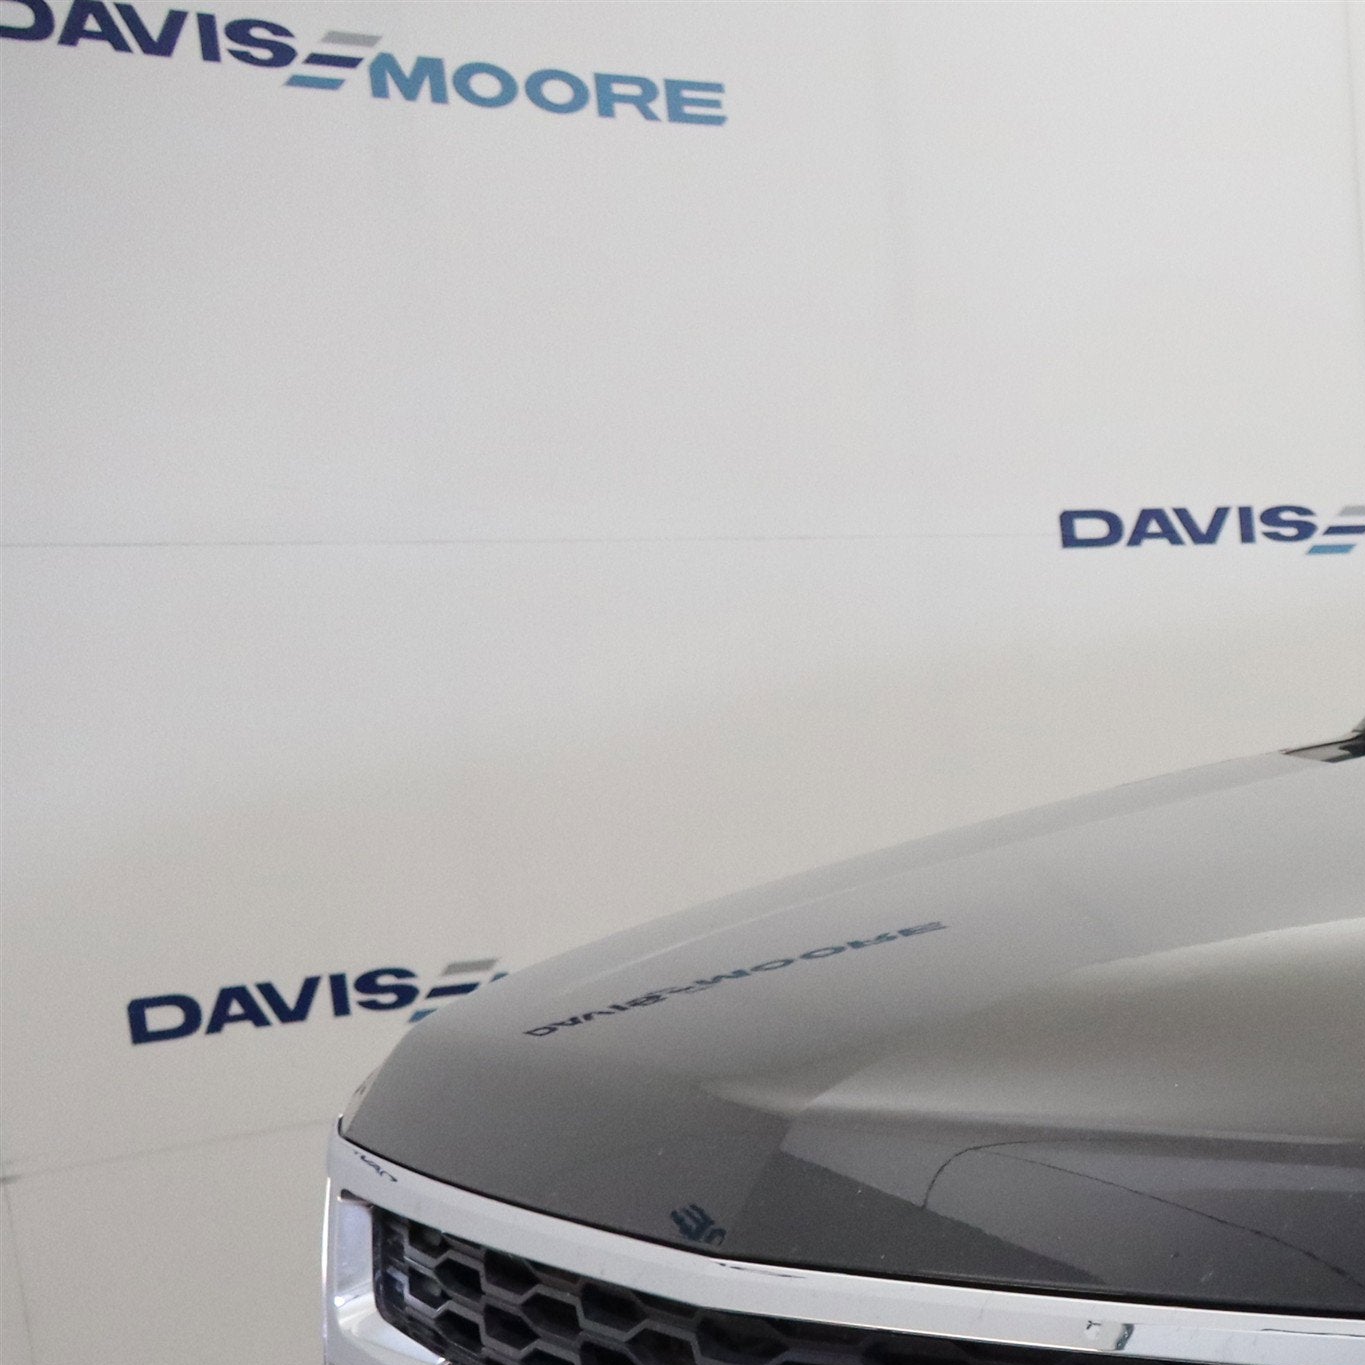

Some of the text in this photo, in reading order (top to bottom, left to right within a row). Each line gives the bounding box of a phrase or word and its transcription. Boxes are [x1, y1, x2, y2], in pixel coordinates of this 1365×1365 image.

[0, 0, 728, 127] DAVIS MOORE
[1059, 504, 1317, 549] DAVIS
[126, 966, 422, 1045] DAVIS
